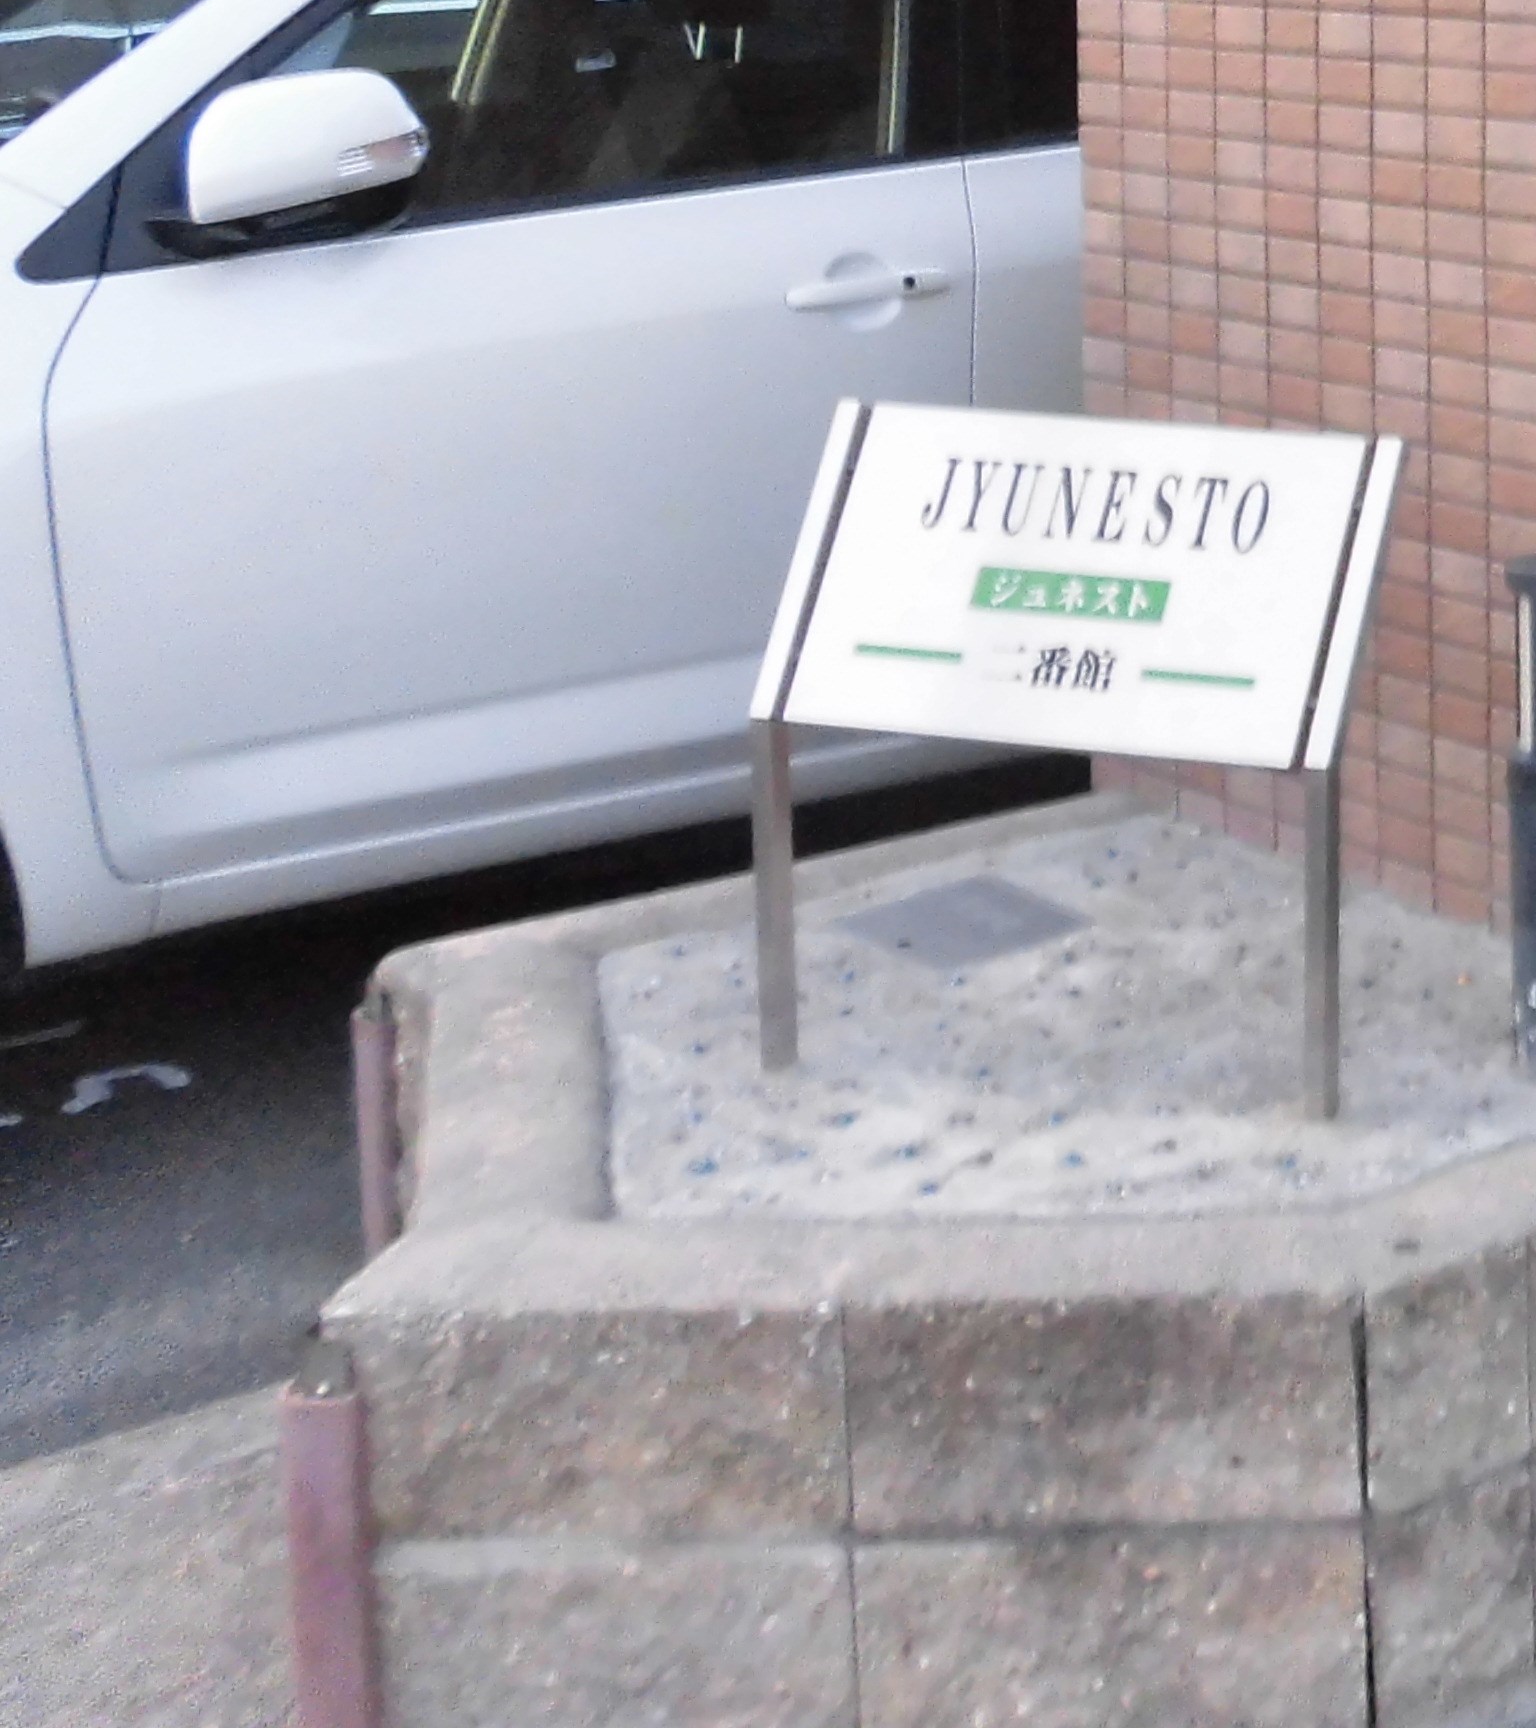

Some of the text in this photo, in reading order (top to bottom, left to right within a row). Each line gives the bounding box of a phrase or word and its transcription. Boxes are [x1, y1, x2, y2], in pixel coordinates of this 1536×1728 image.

[921, 457, 1270, 555] JYUNESTO
[989, 574, 1149, 618] ジュネスト
